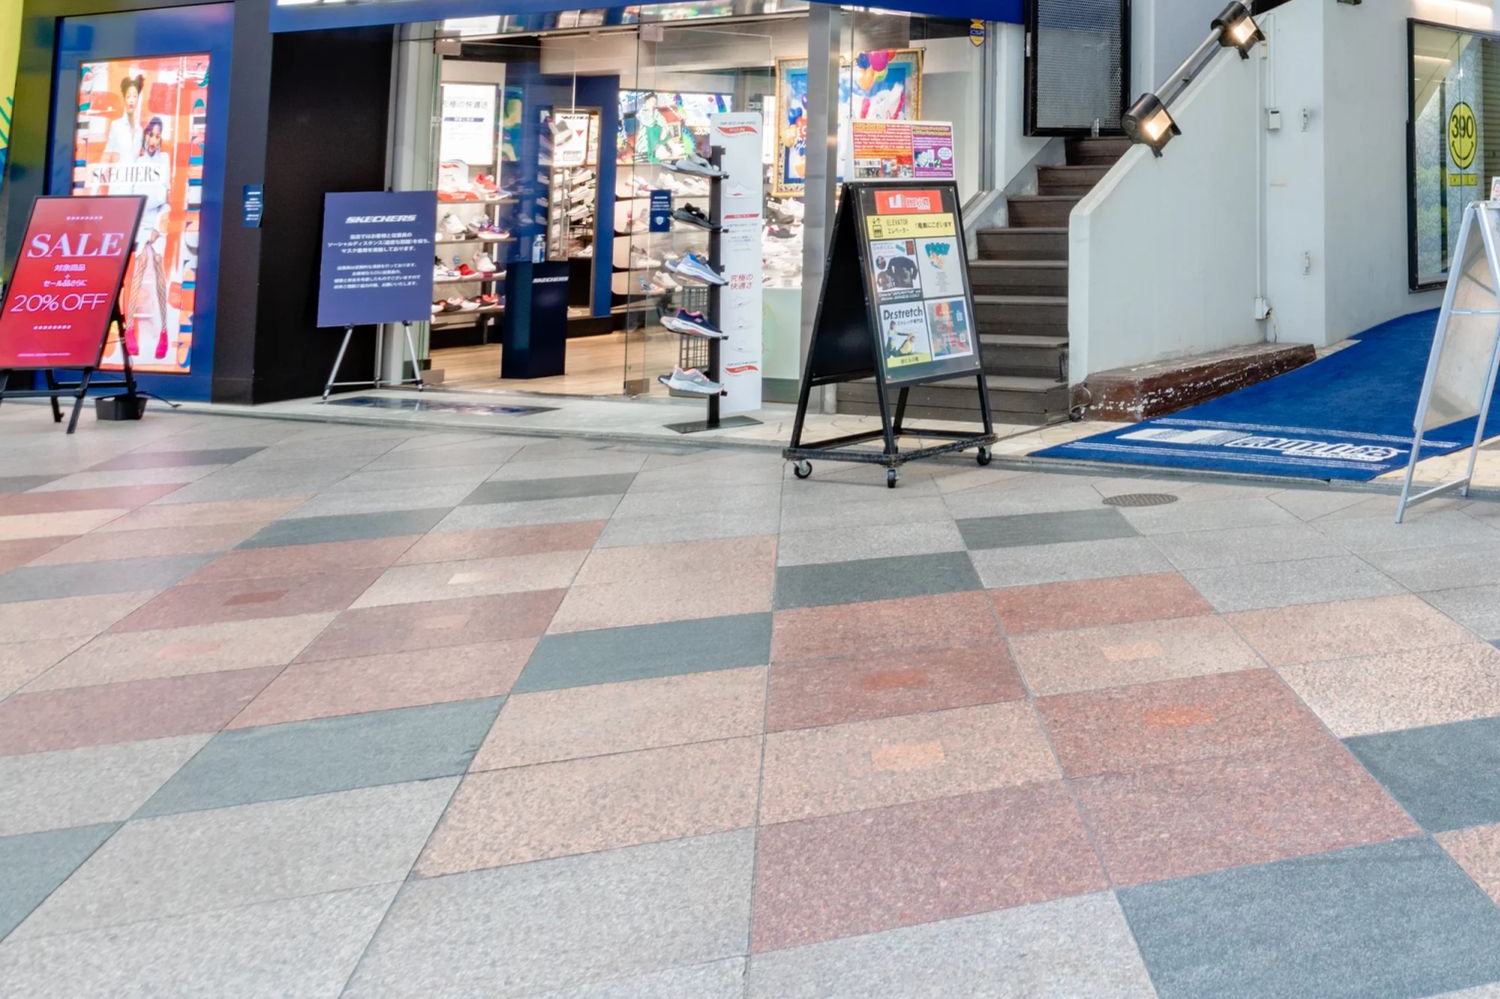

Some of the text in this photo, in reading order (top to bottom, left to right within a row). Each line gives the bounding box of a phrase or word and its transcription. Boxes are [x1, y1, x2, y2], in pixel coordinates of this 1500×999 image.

[1451, 114, 1475, 138] 390
[92, 165, 161, 184] SKECHERS
[26, 232, 125, 258] SALE
[10, 293, 109, 313] 20% OFF
